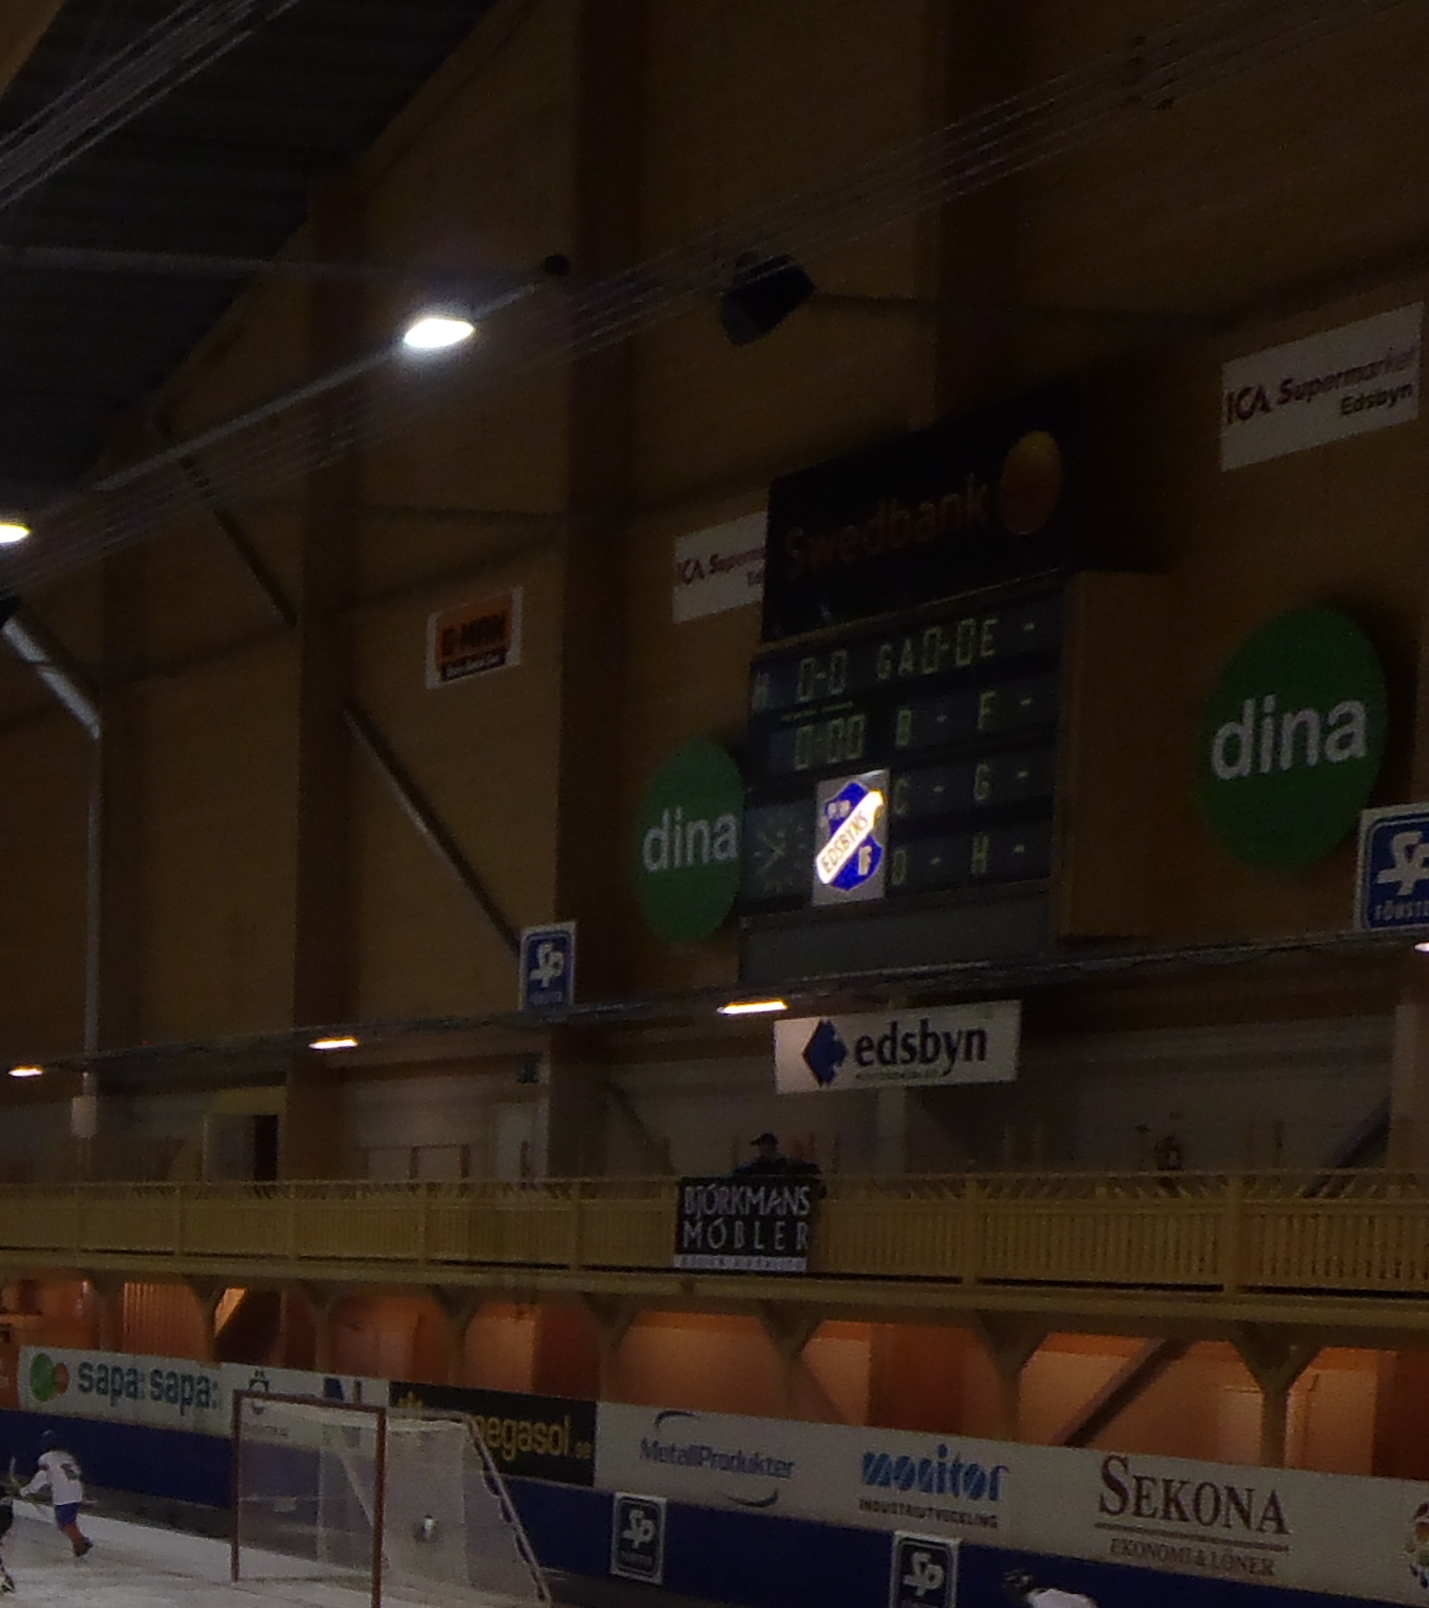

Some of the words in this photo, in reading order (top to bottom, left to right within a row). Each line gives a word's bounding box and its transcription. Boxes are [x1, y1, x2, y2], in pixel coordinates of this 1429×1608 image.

[1226, 384, 1271, 425] ICA
[1341, 383, 1413, 416] Edsbyn
[785, 472, 988, 579] Swedbank
[1210, 692, 1369, 781] dina
[642, 805, 740, 875] dina
[855, 1016, 987, 1077] edsbyn
[862, 1443, 1010, 1501] monitor
[1099, 1455, 1292, 1535] SEKONA
[1109, 1538, 1191, 1568] EKONOMI
